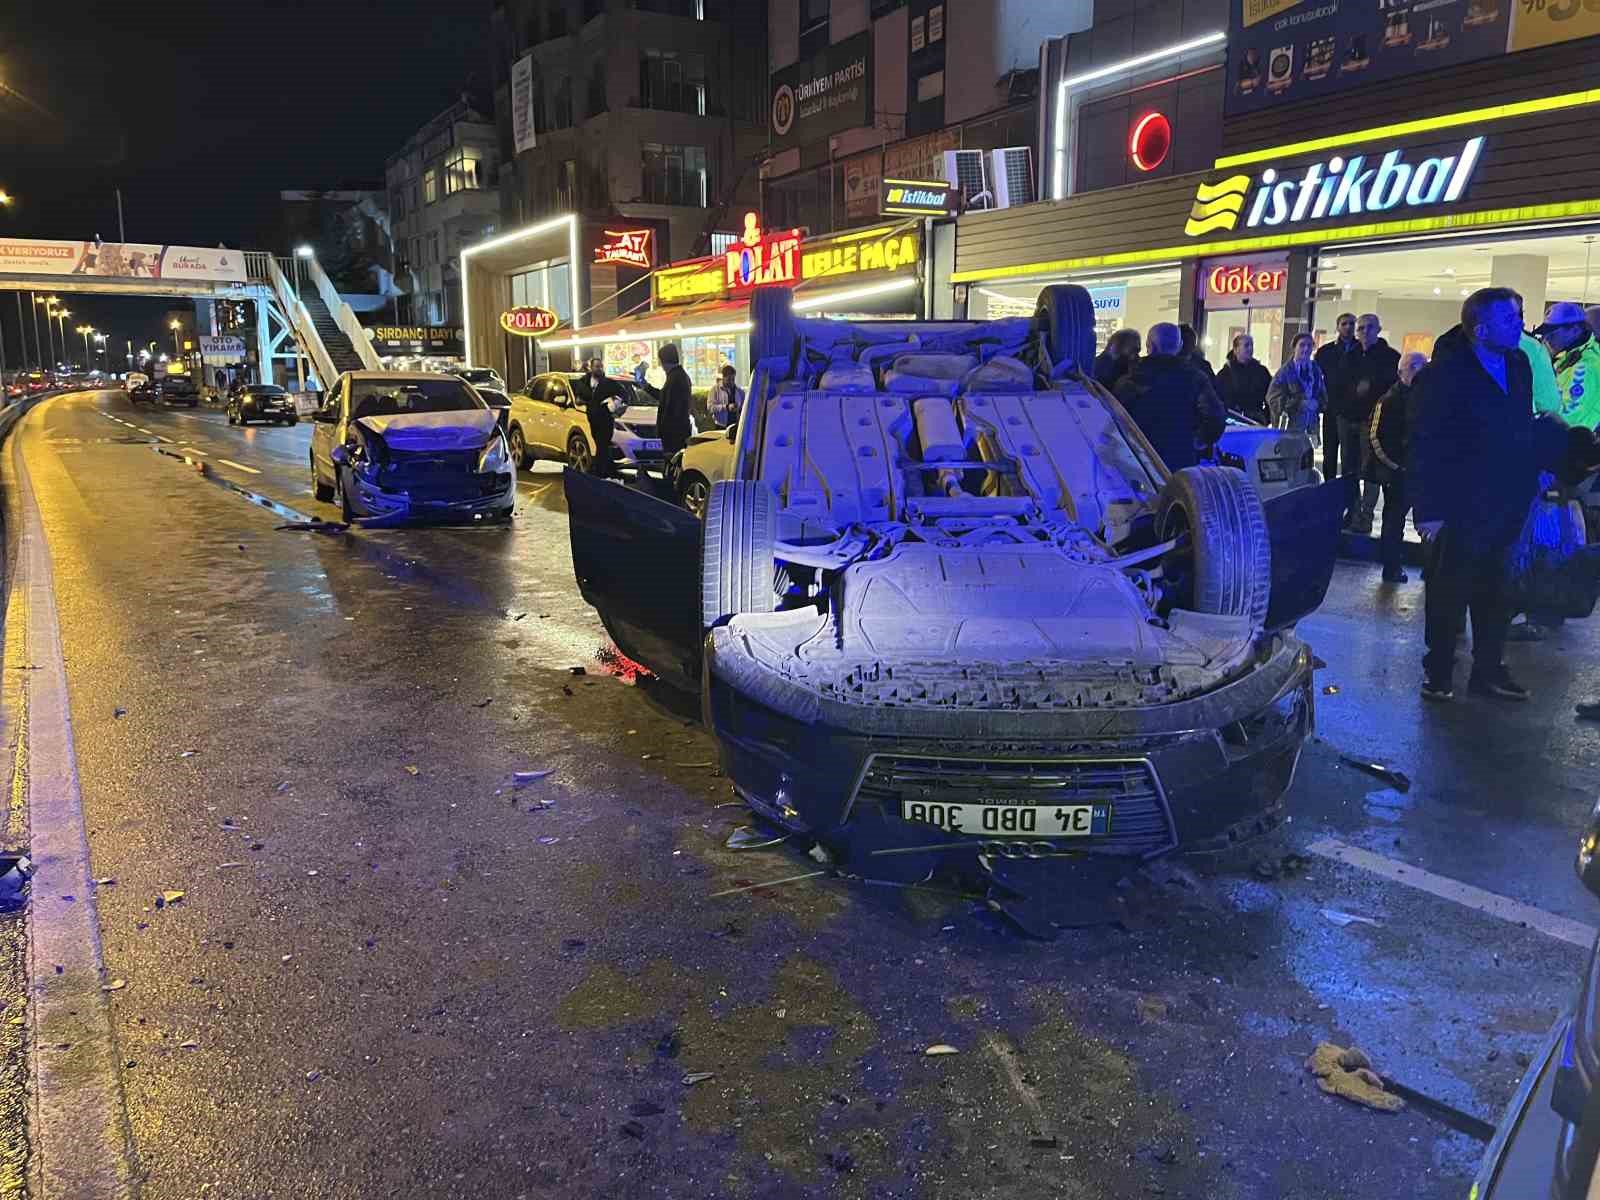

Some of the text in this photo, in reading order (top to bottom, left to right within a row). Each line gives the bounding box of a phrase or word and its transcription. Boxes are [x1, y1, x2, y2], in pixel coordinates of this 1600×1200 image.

[794, 57, 865, 102] TÜRKİYEM PARTİSİ
[1246, 135, 1487, 228] istikbal
[902, 189, 947, 205] istikbal
[726, 239, 798, 288] POLAT
[859, 235, 916, 272] PAÇA
[506, 312, 551, 328] POLAT
[212, 336, 233, 344] OTO
[430, 328, 453, 340] DAYI
[202, 343, 242, 352] YIKAMA
[982, 807, 1037, 832] DBD
[1055, 807, 1090, 832] 34
